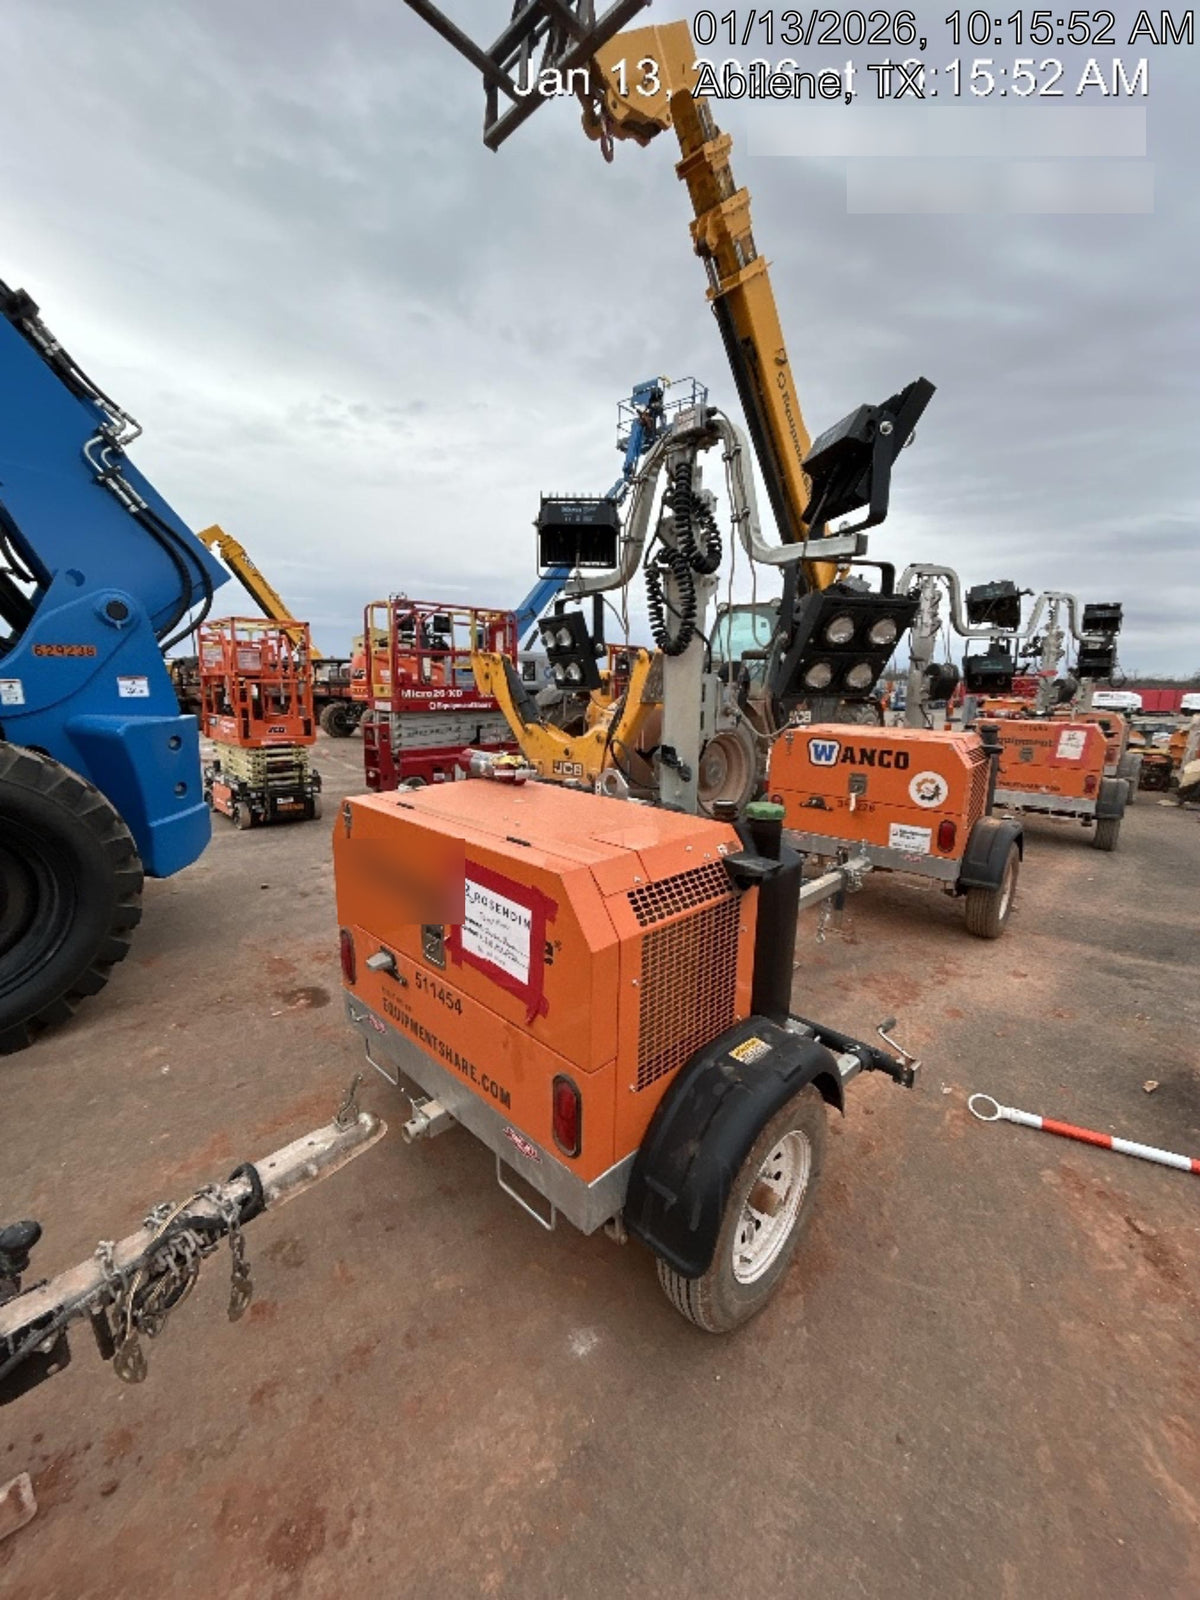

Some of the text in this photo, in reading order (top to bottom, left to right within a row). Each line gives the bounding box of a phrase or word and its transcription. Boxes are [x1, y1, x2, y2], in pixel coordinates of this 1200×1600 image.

[553, 761, 583, 777] JCB
[808, 738, 910, 770] WANCO
[414, 971, 464, 1016] 511454
[382, 996, 512, 1111] EQUIPMENTSHARE.COM
